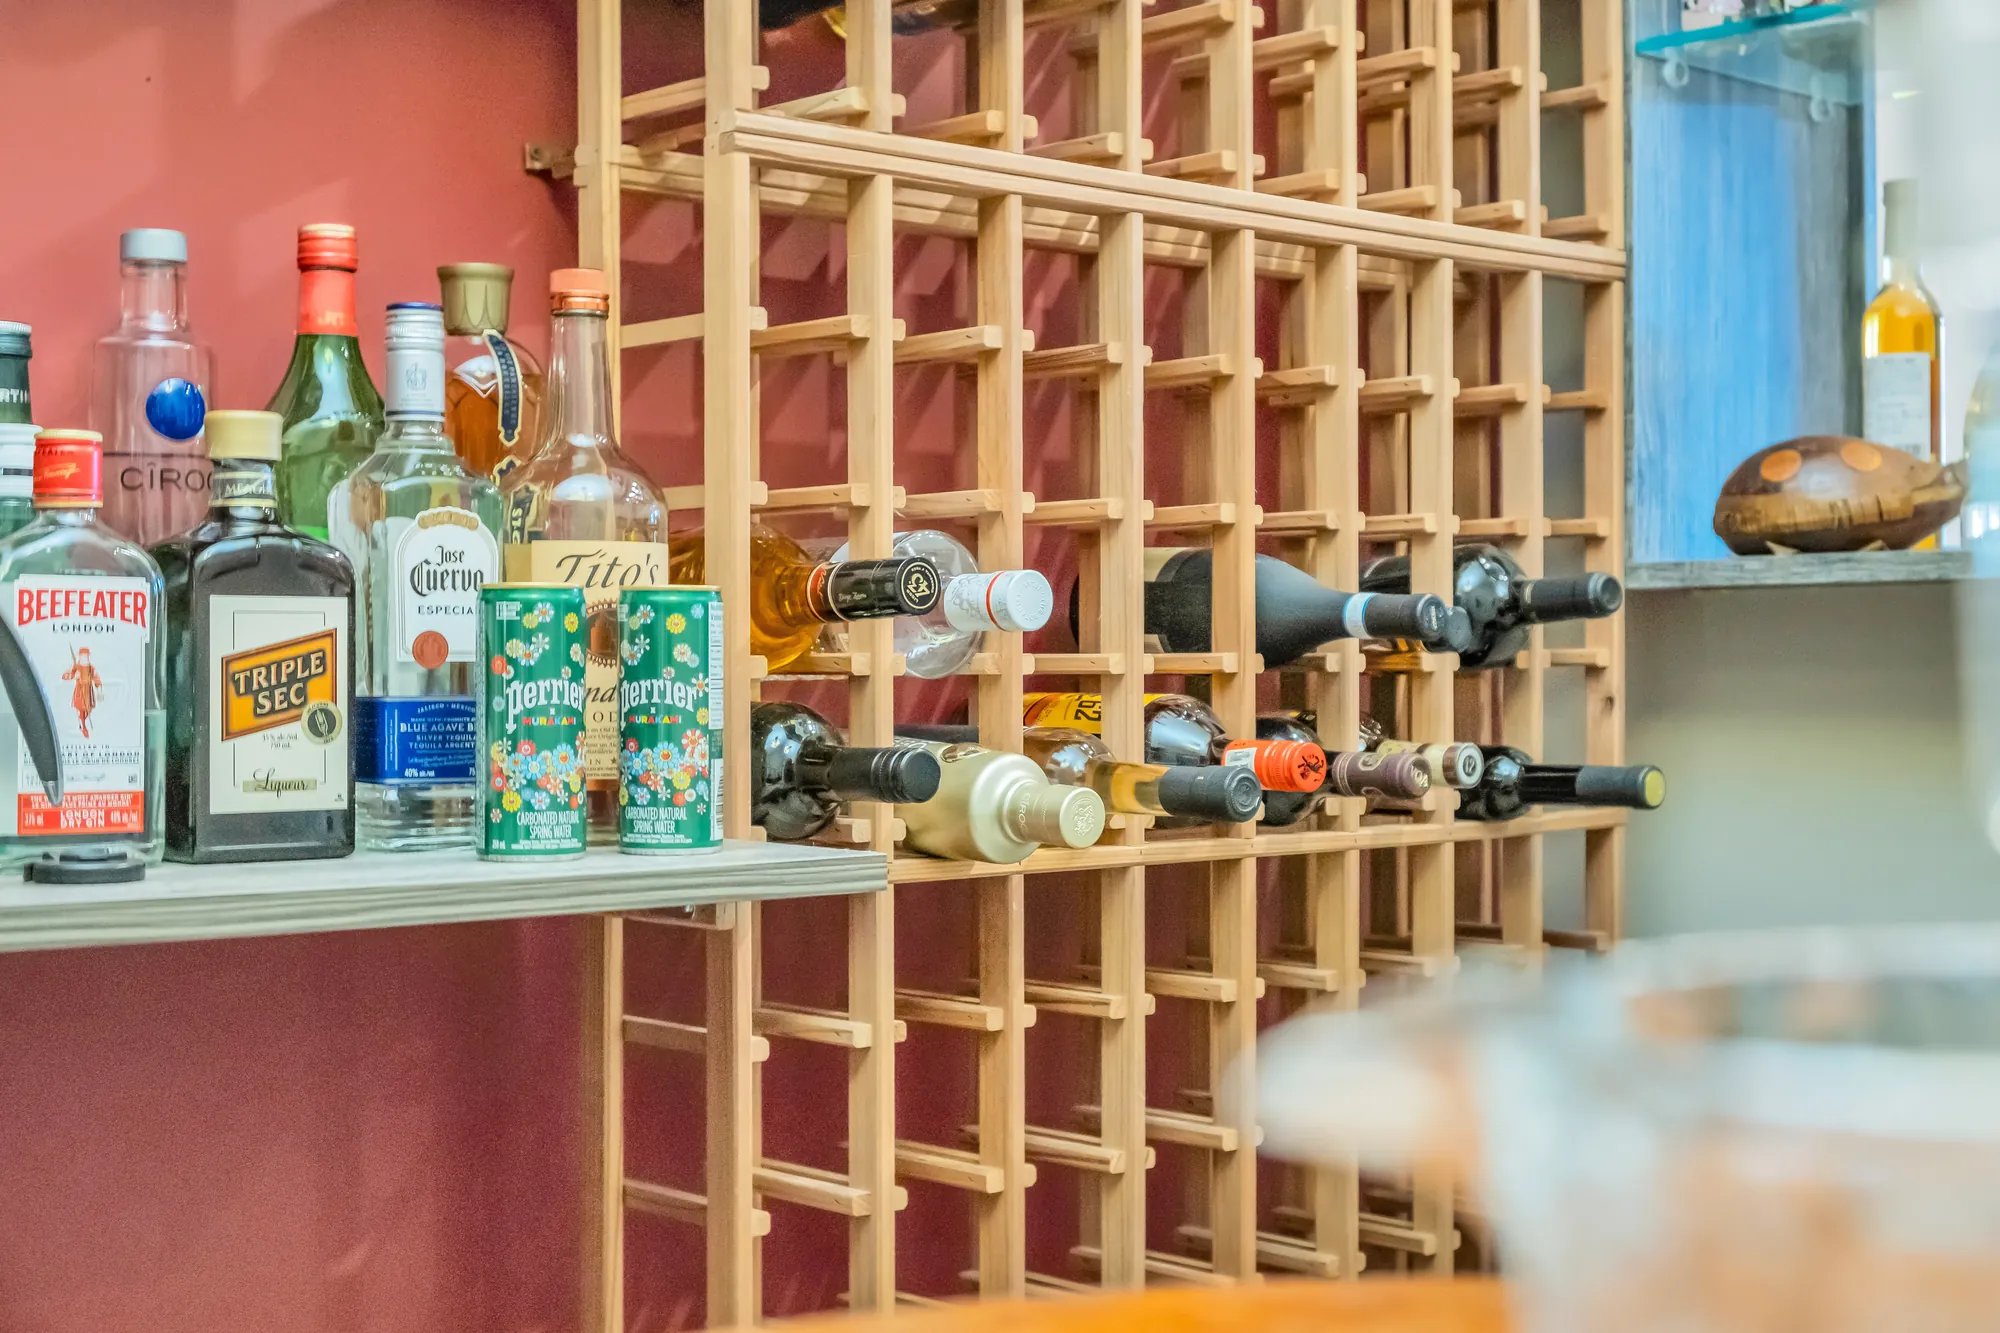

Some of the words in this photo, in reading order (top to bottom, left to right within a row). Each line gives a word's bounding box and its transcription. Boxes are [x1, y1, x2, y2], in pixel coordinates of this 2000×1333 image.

[121, 462, 213, 492] CÎRO
[435, 545, 465, 567] Jose
[556, 549, 659, 589] Tito's
[410, 558, 484, 597] Cuervo
[18, 589, 147, 628] BEEFEATER
[418, 605, 474, 615] ESPECIA
[52, 623, 115, 633] LONDON
[234, 651, 325, 695] TRIPLE
[256, 682, 305, 715] SEC
[522, 717, 577, 725] MURAKAMI
[629, 714, 682, 724] MURAKAMI
[400, 723, 428, 733] BLUE
[431, 723, 465, 733] AGAVE
[468, 723, 476, 732] B
[404, 768, 418, 778] 40%
[253, 769, 308, 798] Liqueur
[60, 808, 105, 819] LONDON
[516, 812, 557, 826] CARBONATED
[559, 810, 580, 824] NATURAL
[625, 807, 658, 820] CARBONATED
[659, 807, 688, 820] NATURAL
[60, 818, 80, 829] DRY
[86, 816, 105, 828] GIN
[633, 820, 653, 834] SPRING
[654, 820, 676, 834] WATER
[529, 825, 552, 840] SPRING
[553, 824, 572, 838] WATER
